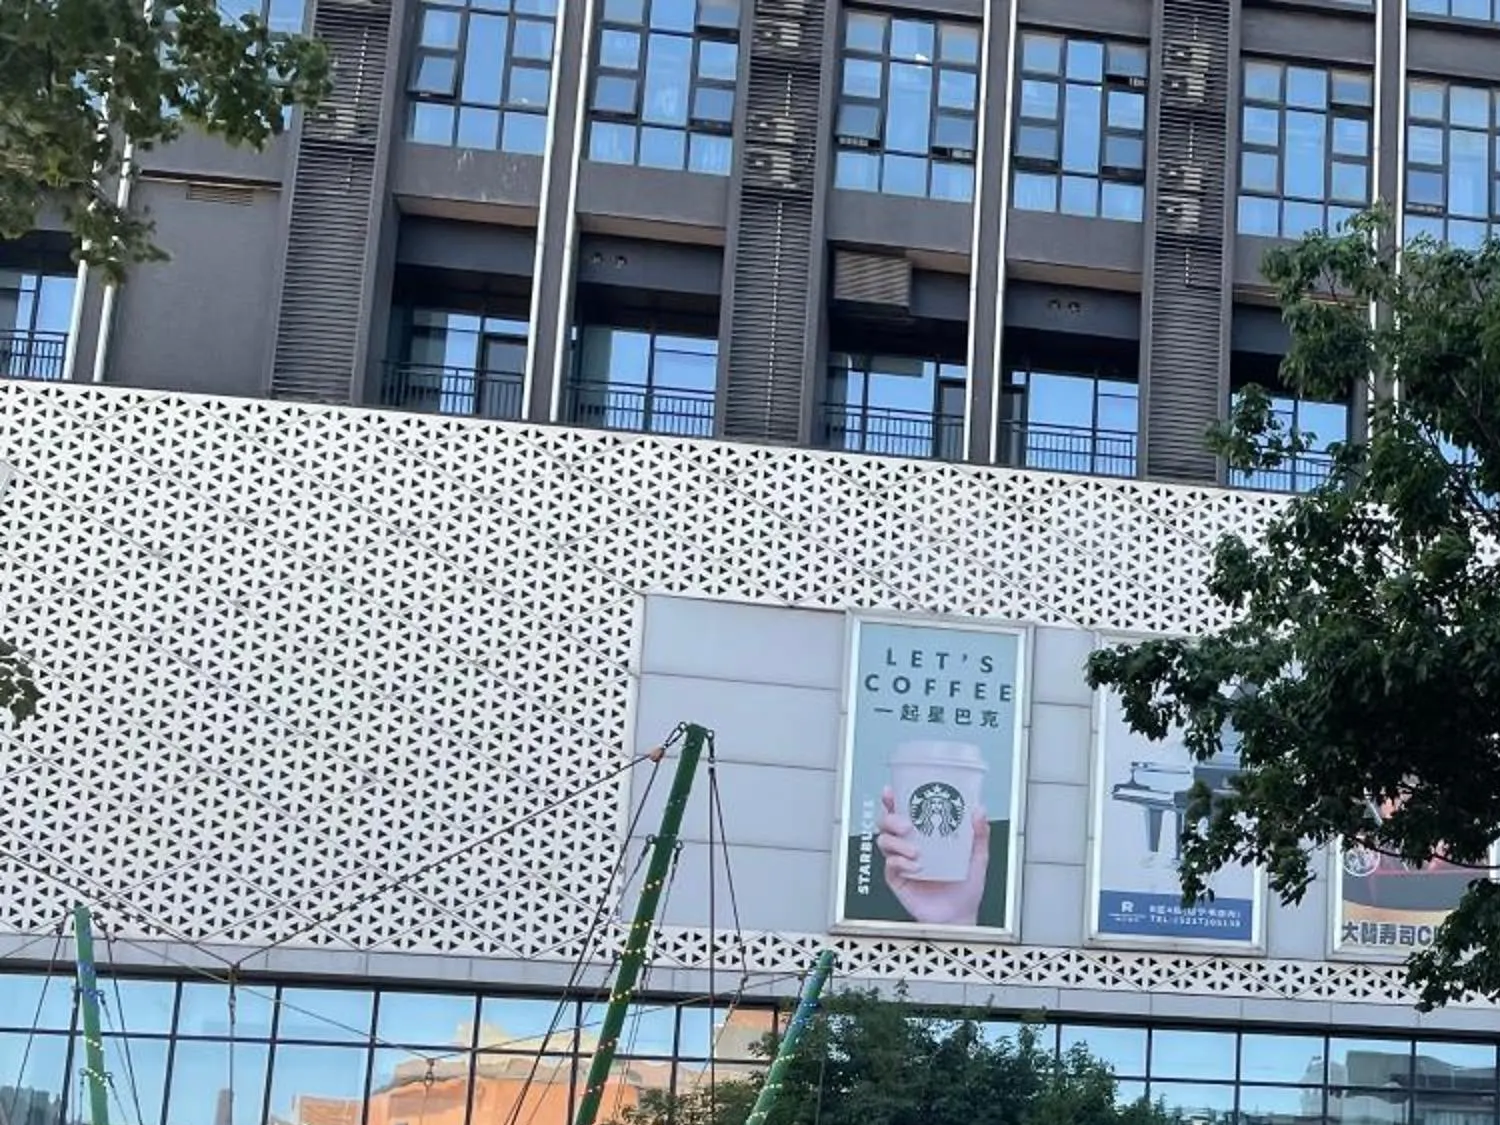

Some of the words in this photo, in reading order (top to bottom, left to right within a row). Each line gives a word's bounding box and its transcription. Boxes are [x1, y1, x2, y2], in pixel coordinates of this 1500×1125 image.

[886, 647, 994, 674] LET'S
[864, 673, 1013, 702] COFFEE
[873, 703, 1000, 729] 一起星巴克
